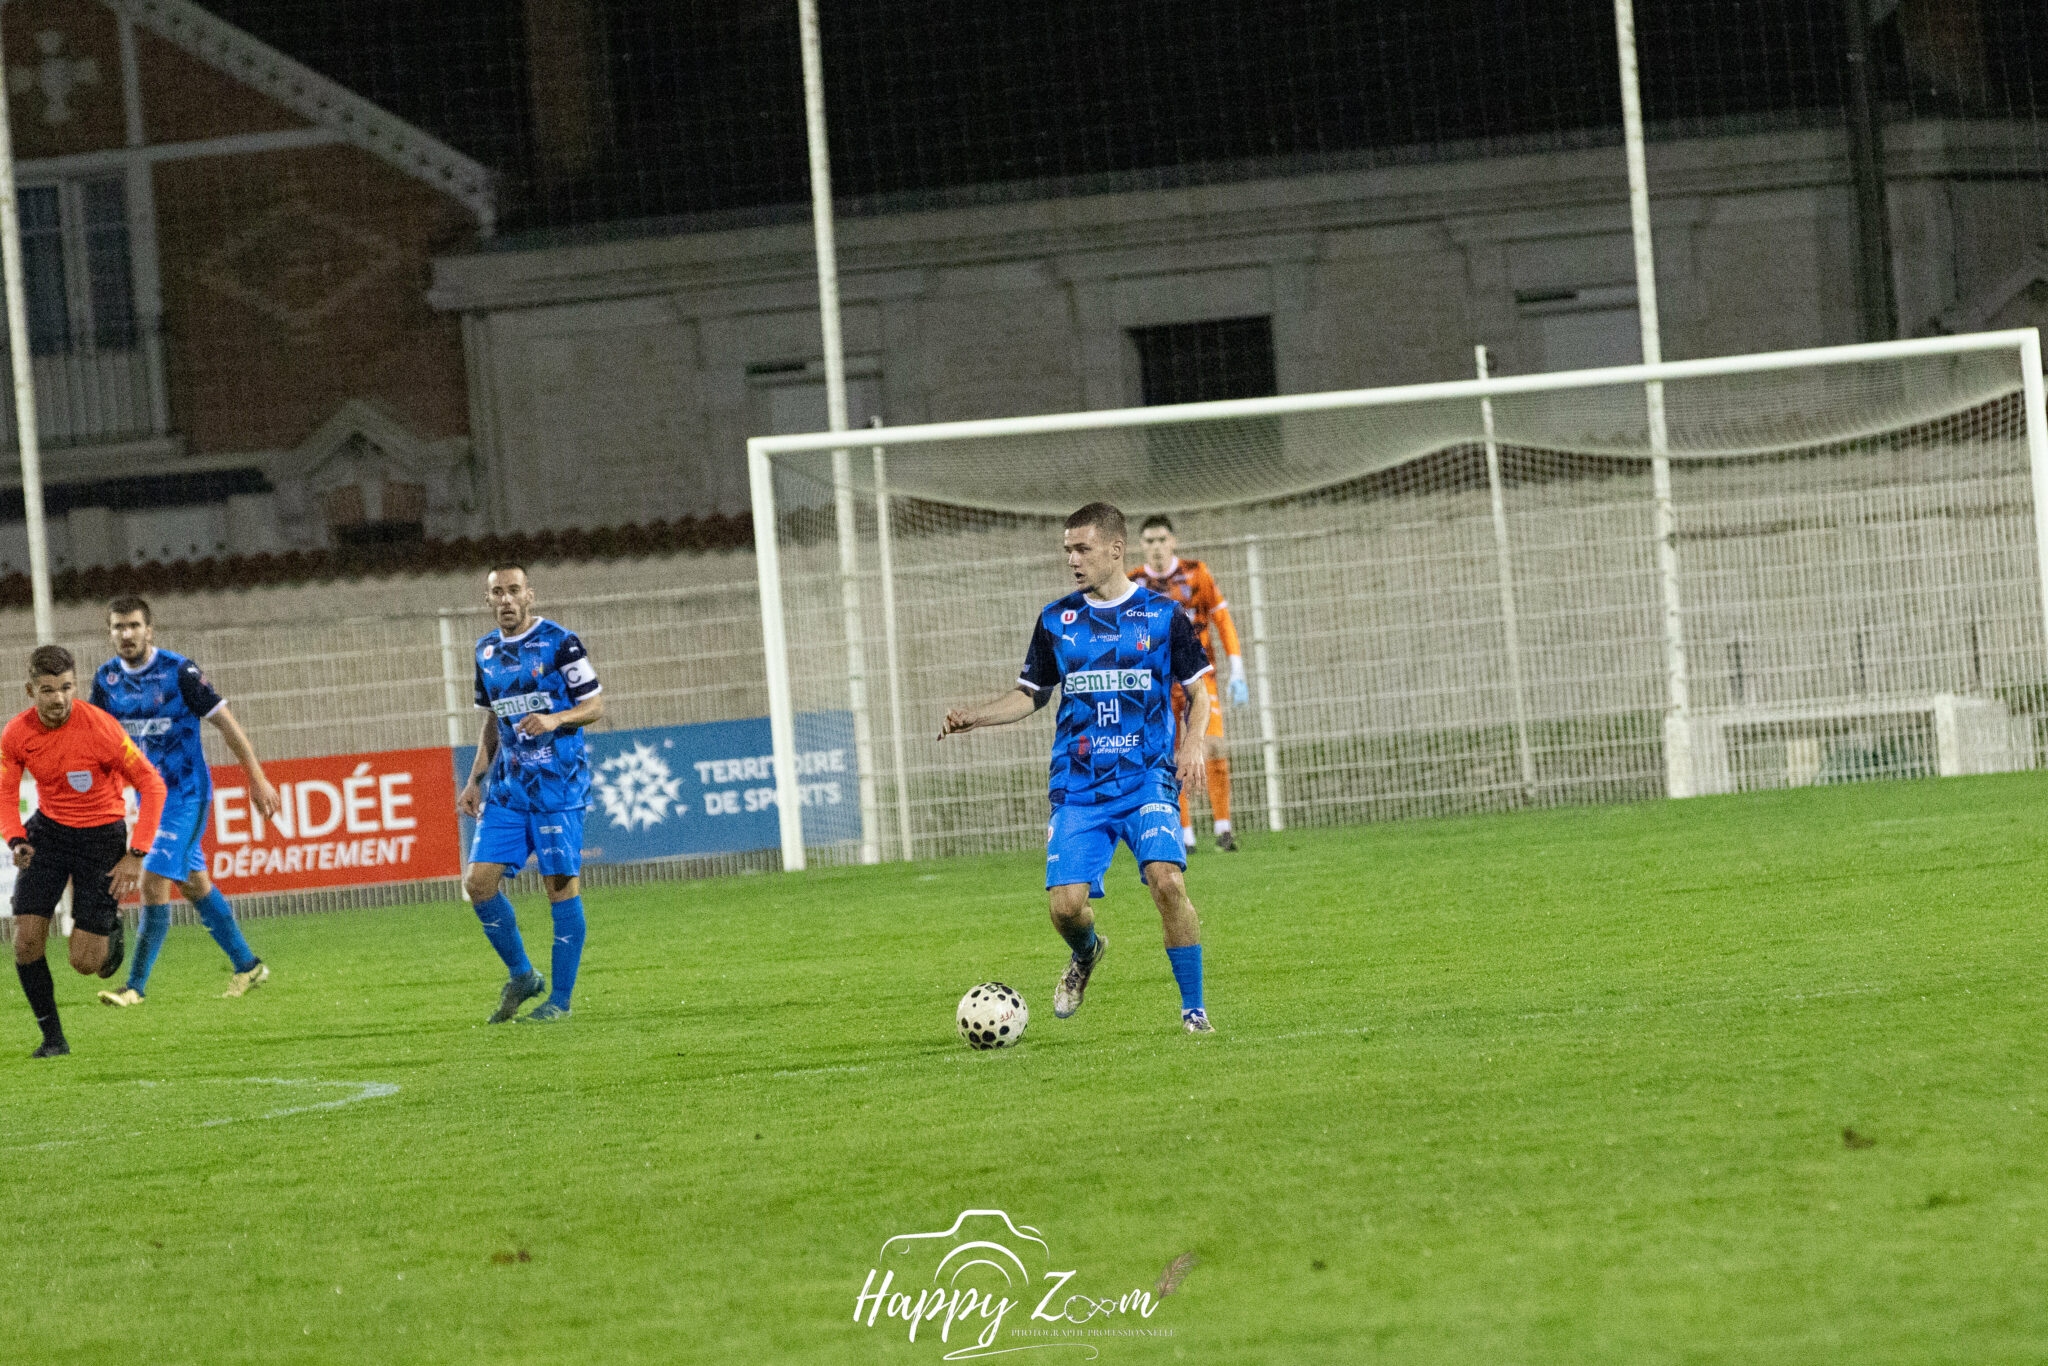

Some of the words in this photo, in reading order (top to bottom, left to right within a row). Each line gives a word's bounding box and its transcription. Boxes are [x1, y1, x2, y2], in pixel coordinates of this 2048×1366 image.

[1126, 609, 1160, 618] Groupe
[565, 667, 582, 684] C
[1065, 671, 1150, 692] semi-loc
[493, 693, 549, 715] emi-loc
[1090, 733, 1140, 748] VENDÉE
[694, 749, 846, 784] TERRIIRE
[212, 762, 417, 844] ENDÉE
[703, 790, 741, 816] DE
[743, 781, 842, 813] SPRTS
[212, 835, 416, 880] DÉPARTEMENT
